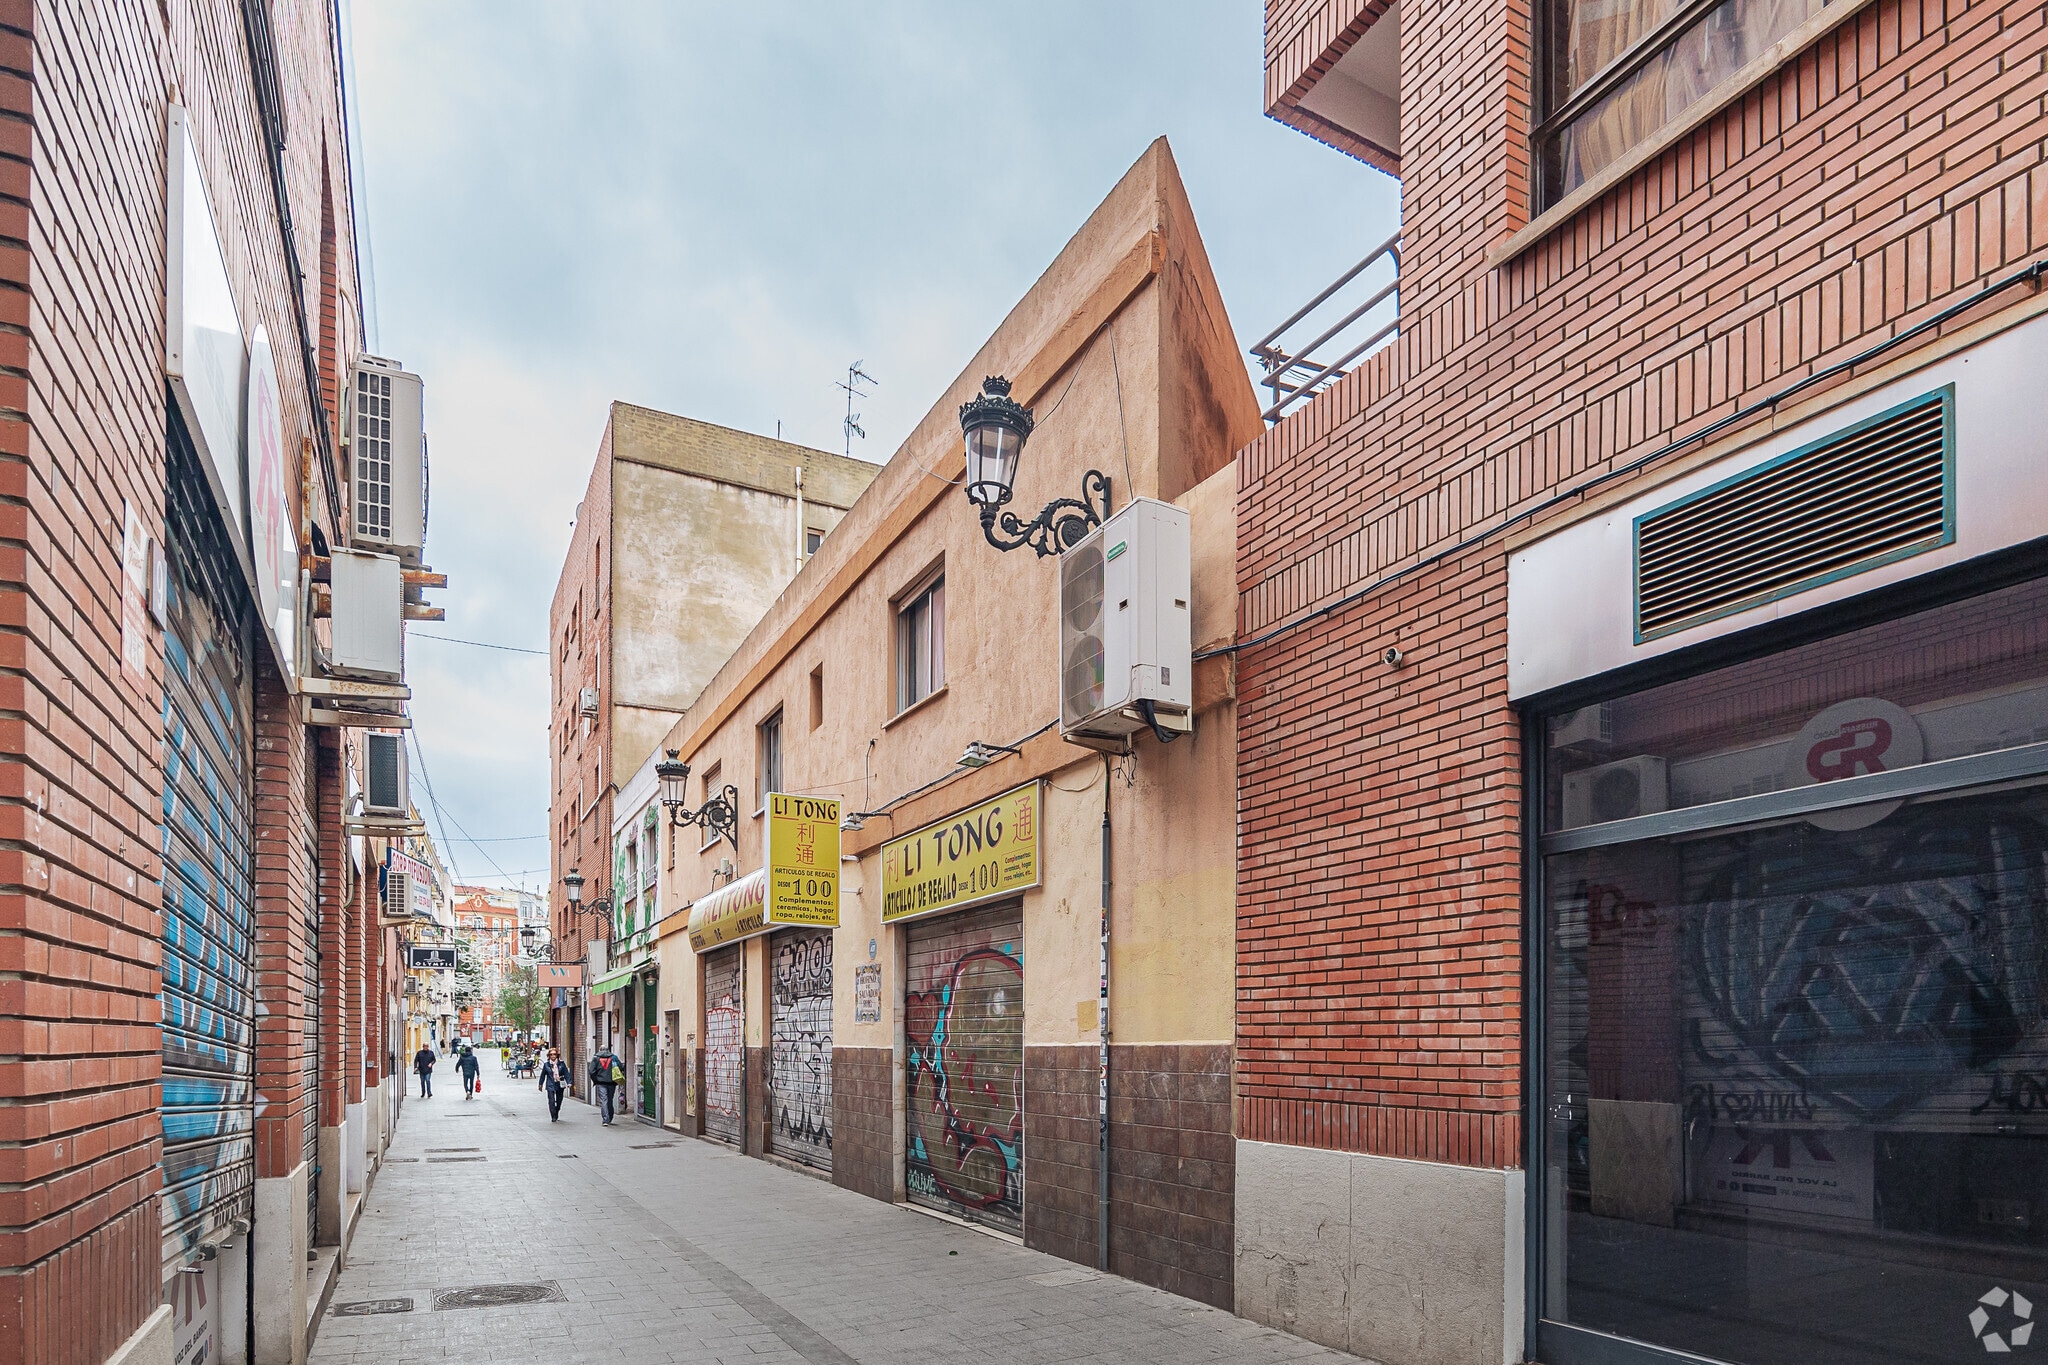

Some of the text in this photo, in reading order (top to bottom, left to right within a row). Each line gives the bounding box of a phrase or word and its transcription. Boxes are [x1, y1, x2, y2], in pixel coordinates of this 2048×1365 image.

[156, 560, 163, 610] 9
[774, 797, 837, 821] LI TONG
[904, 838, 921, 877] LI
[933, 806, 1003, 867] TONG
[1012, 795, 1033, 844] 通
[774, 867, 836, 879] ARTICULOS DE REGALO
[727, 874, 765, 916] TONG
[777, 878, 832, 898] DESDE 100
[883, 860, 999, 917] ARTICULOS DE REGALO DESDE 100
[778, 895, 834, 906] Complementos:
[814, 906, 834, 915] hogar
[775, 911, 795, 919] ropa,
[796, 912, 821, 921] relojes,
[184, 1338, 192, 1356] DEL
[193, 1320, 208, 1345] BARRIO
